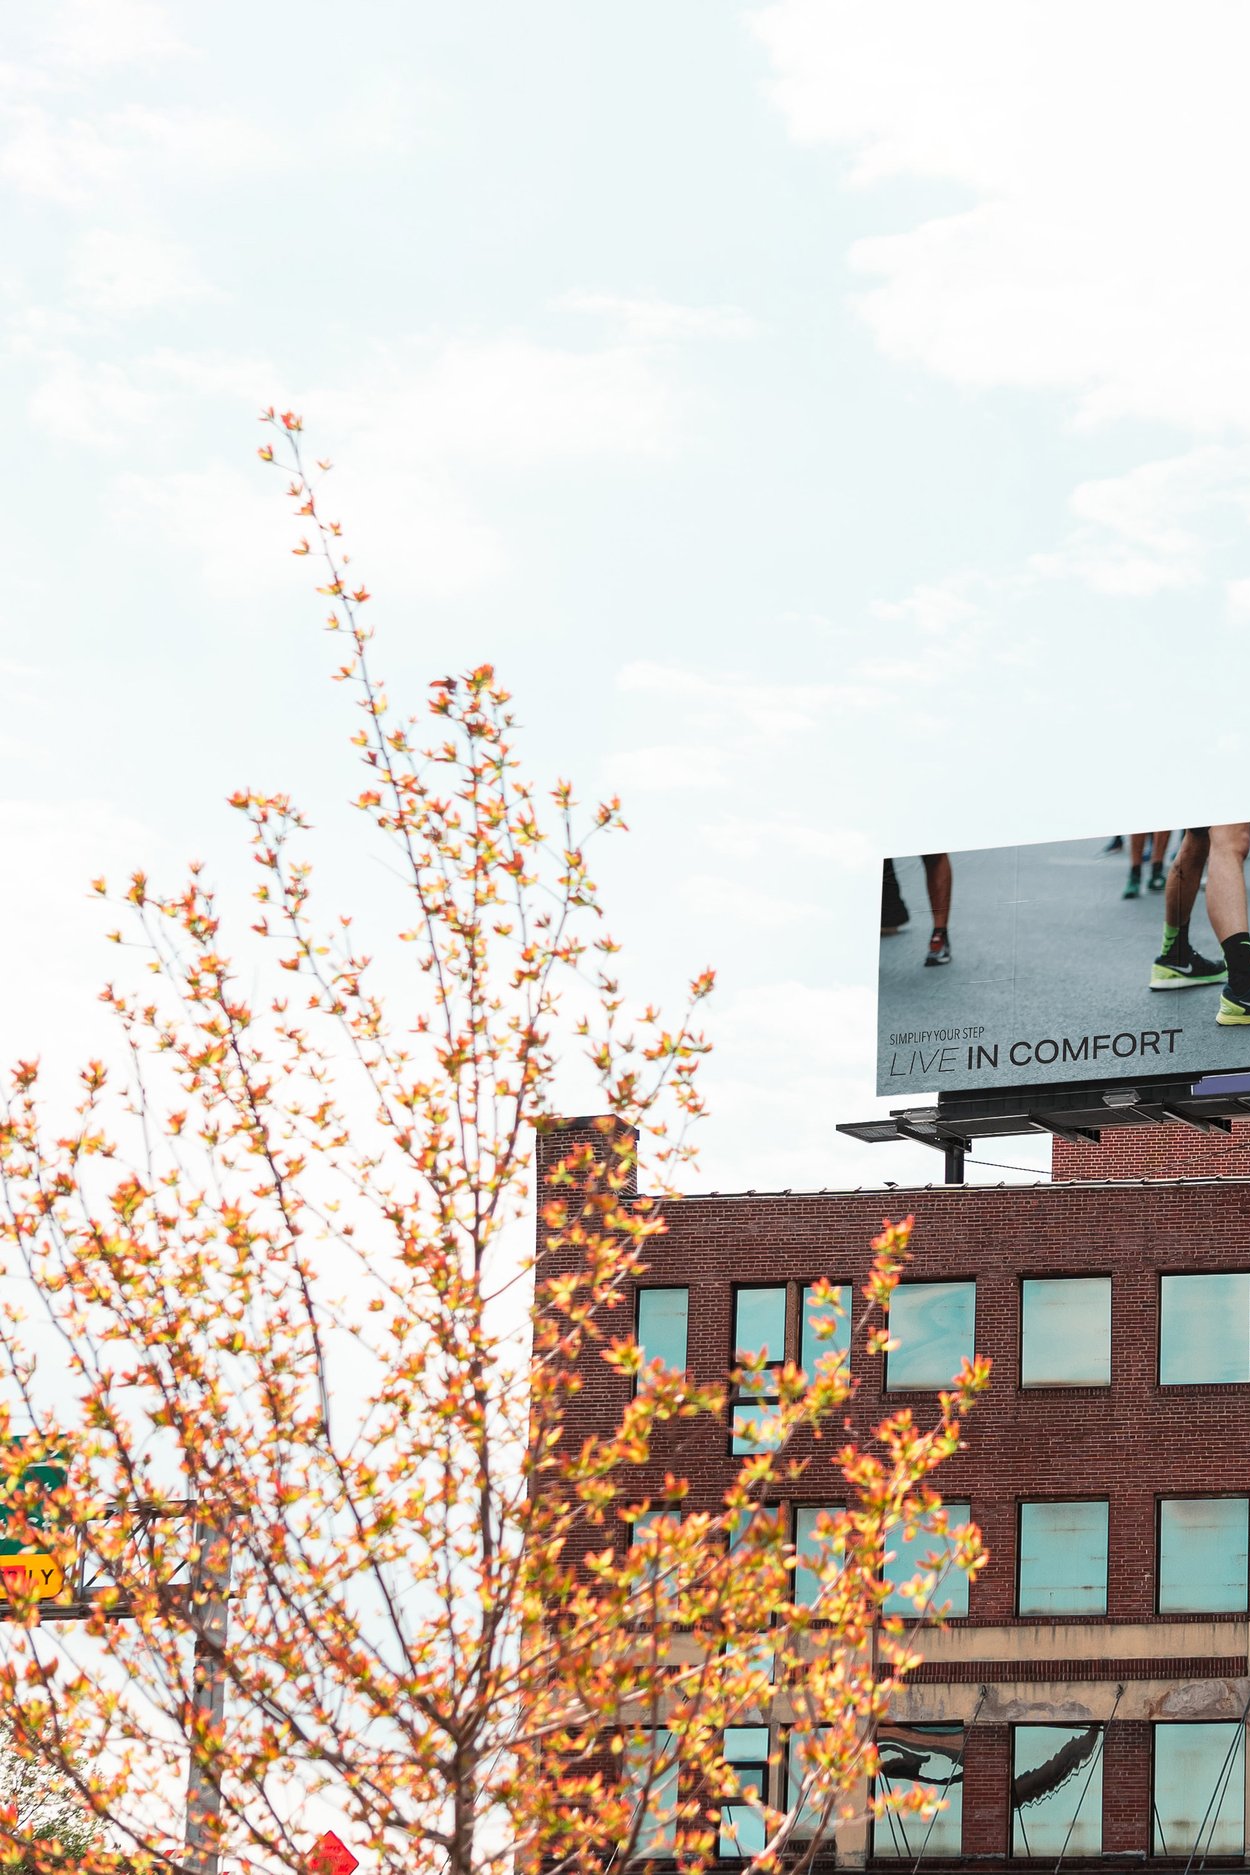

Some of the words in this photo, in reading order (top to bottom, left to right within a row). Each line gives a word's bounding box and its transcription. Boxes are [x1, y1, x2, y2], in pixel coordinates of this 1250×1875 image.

[889, 1031, 933, 1046] SIMPLIFY
[933, 1028, 961, 1042] YOUR
[962, 1026, 985, 1040] STEP
[889, 1047, 960, 1077] LIVE
[967, 1043, 999, 1070] IN
[1008, 1028, 1184, 1067] COMFORT
